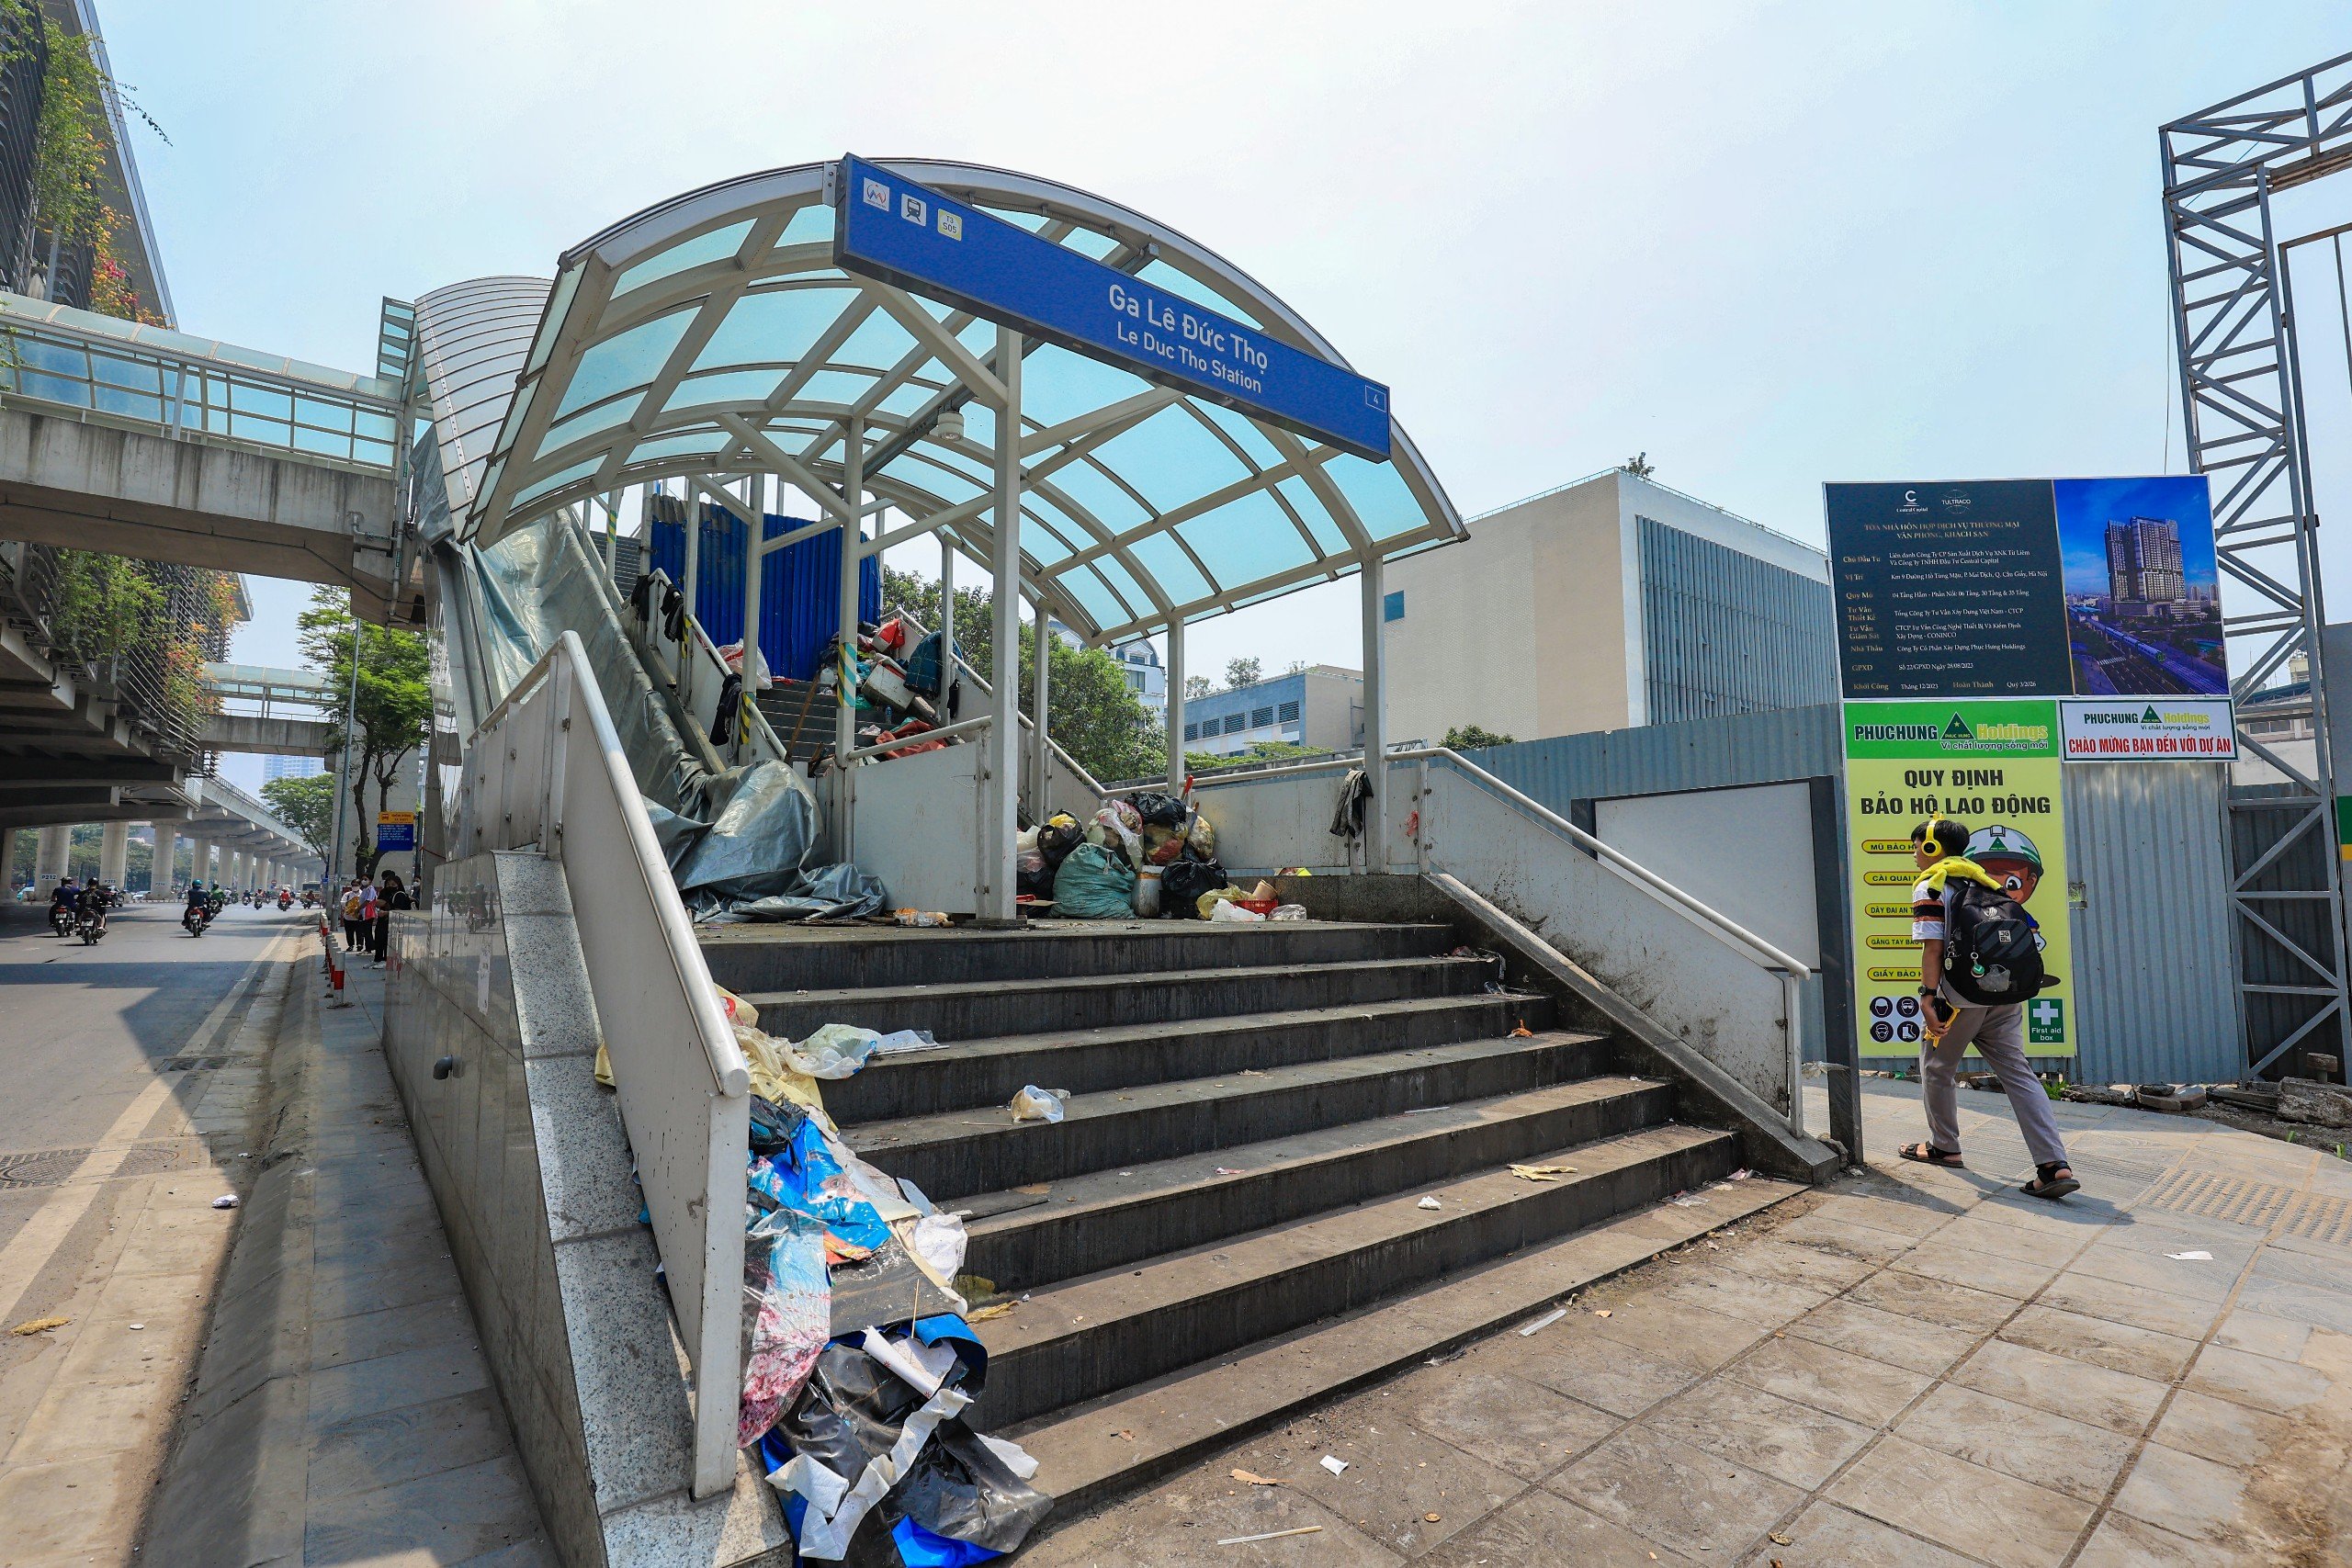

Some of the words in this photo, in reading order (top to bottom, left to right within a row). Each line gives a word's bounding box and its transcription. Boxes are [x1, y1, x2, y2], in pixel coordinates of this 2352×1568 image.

[946, 215, 954, 224] T3
[943, 222, 957, 234] S05
[1109, 284, 1139, 318] Ga
[1148, 299, 1176, 332] Lê
[1182, 313, 1225, 352] Đức
[1229, 333, 1268, 375] Thọ
[1117, 321, 1138, 345] Le
[1144, 331, 1175, 359] Duc
[1178, 345, 1207, 372] Tho
[1211, 359, 1261, 394] Station
[1373, 394, 1379, 404] 4
[1871, 682, 1889, 691] Công
[2084, 713, 2138, 724] PHUCHUNG
[2163, 713, 2210, 724] Holdings
[1854, 724, 1938, 741] PHUCHUNG
[1977, 723, 2048, 741] Holdings
[1953, 740, 1972, 749] chất
[1974, 741, 2003, 751] lượng
[2005, 739, 2027, 750] sống
[2030, 740, 2048, 749] mới
[2069, 735, 2096, 753] CHÀO
[2099, 735, 2130, 753] MỪNG
[2133, 738, 2154, 756] BẠN
[2156, 733, 2177, 752] ĐẾN
[2180, 734, 2197, 752] VỚI
[2200, 737, 2214, 756] DỰ
[2216, 736, 2231, 752] ÁN
[1904, 770, 1945, 789] QUY
[1952, 769, 2004, 790] ĐỊNH
[1860, 791, 1903, 814] BẢO
[1910, 794, 1938, 818] HỘ
[1946, 797, 1984, 814] LAO
[1991, 793, 2051, 818] ĐỘNG
